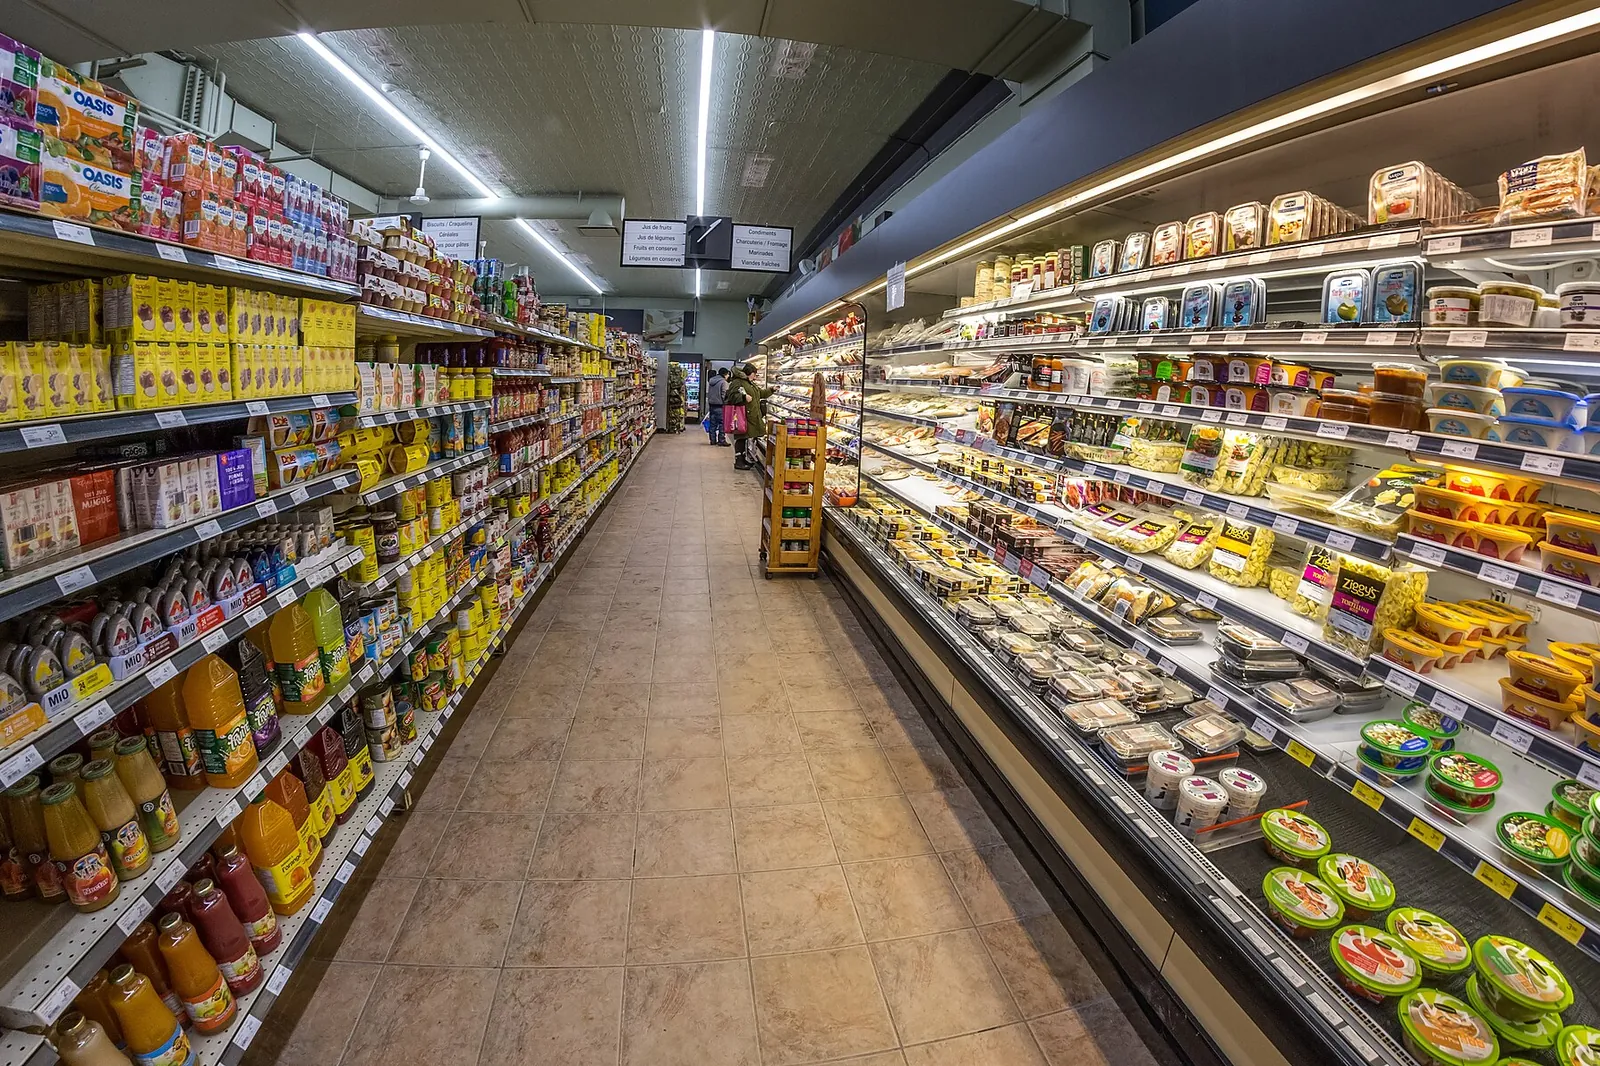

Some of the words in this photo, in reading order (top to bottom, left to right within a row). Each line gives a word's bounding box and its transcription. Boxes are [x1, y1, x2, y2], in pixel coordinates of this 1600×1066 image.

[73, 91, 115, 116] OASIS
[82, 167, 123, 190] OASIS
[273, 416, 288, 424] Dole
[281, 454, 296, 463] Dole
[1342, 578, 1380, 599] Ziggy's
[181, 622, 196, 637] MiO
[124, 653, 141, 670] MiO
[78, 682, 86, 691] 24
[48, 688, 69, 708] MiO
[4, 726, 13, 736] 24
